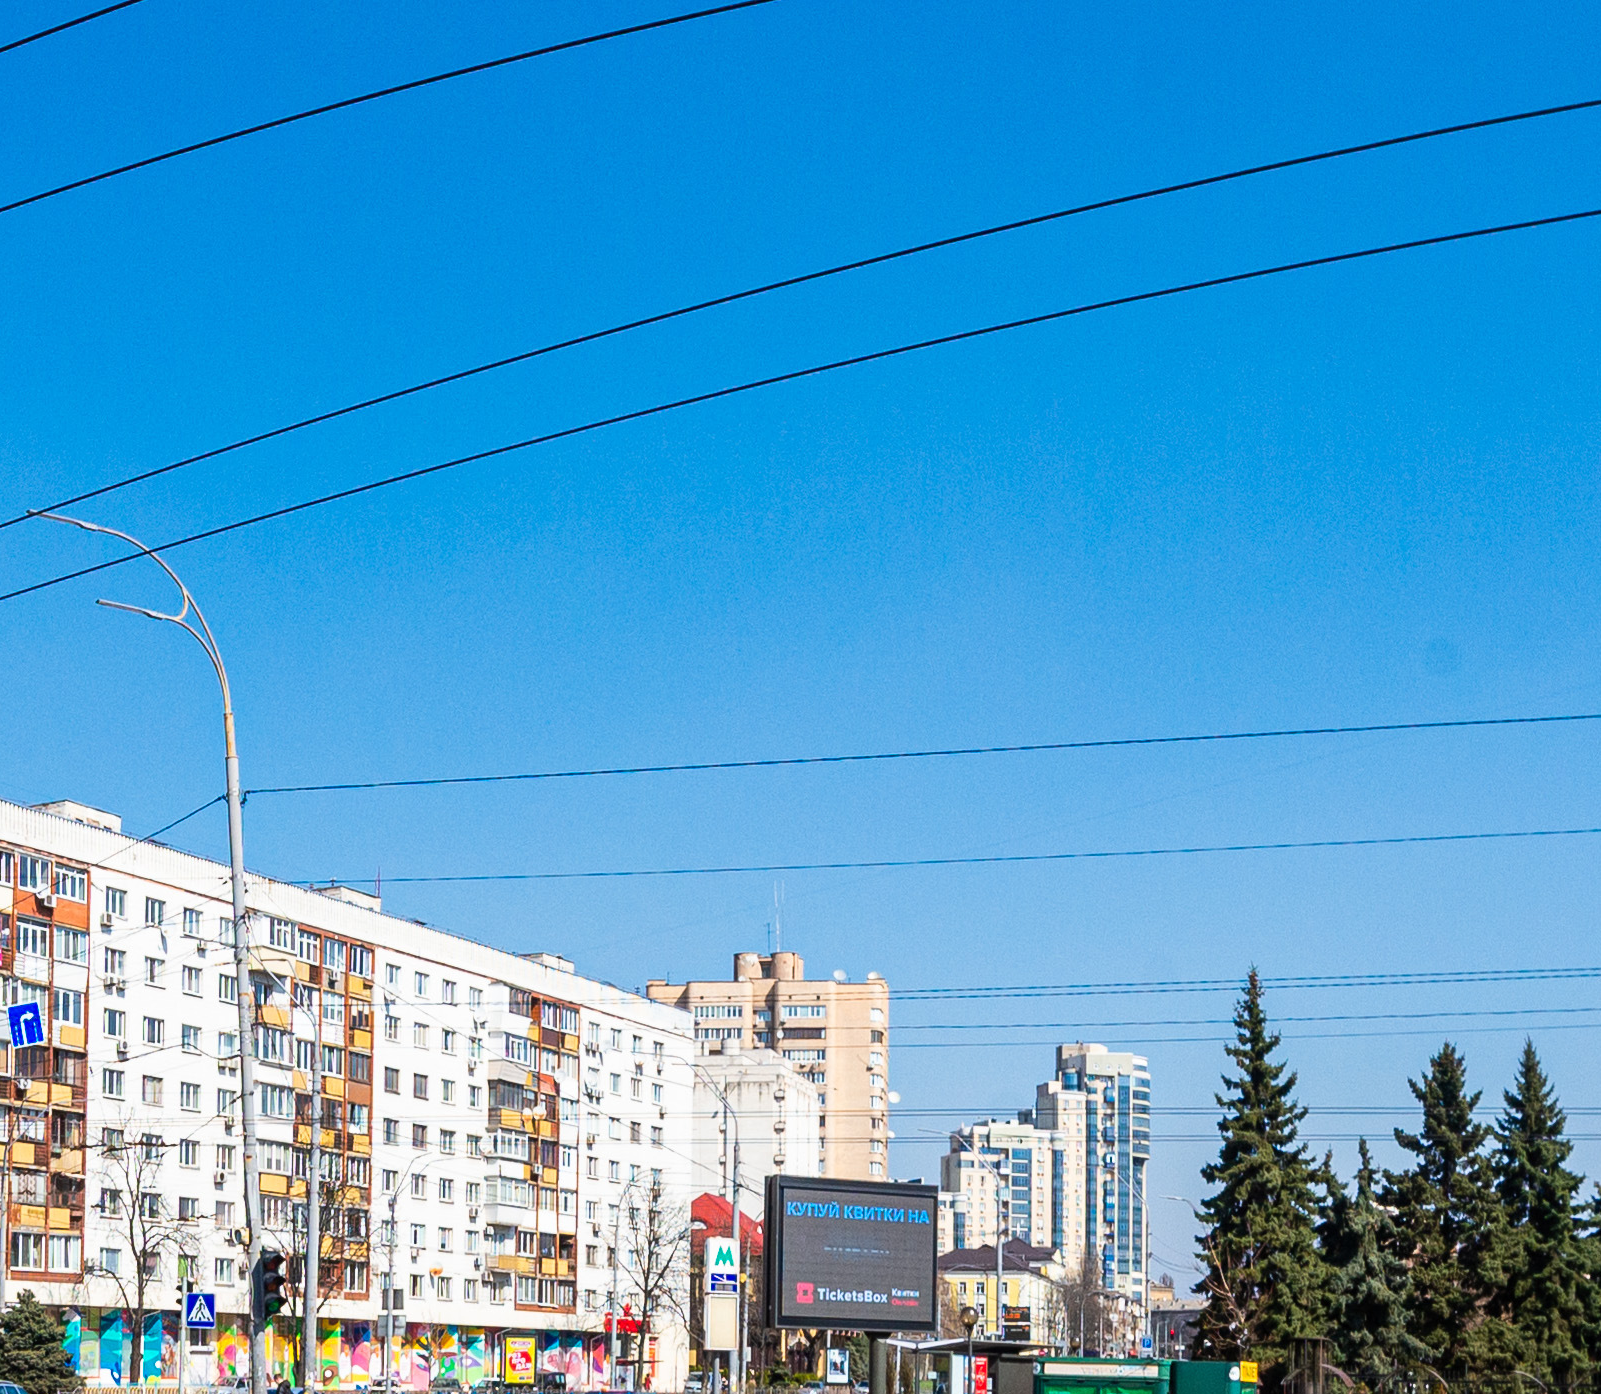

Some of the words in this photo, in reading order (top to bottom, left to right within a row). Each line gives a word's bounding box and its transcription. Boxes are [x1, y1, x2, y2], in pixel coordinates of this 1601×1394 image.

[786, 1201, 840, 1218] КУПУЙ
[843, 1205, 905, 1223] КВИТКИ
[908, 1209, 930, 1225] НА
[817, 1287, 888, 1304] TicketsBox
